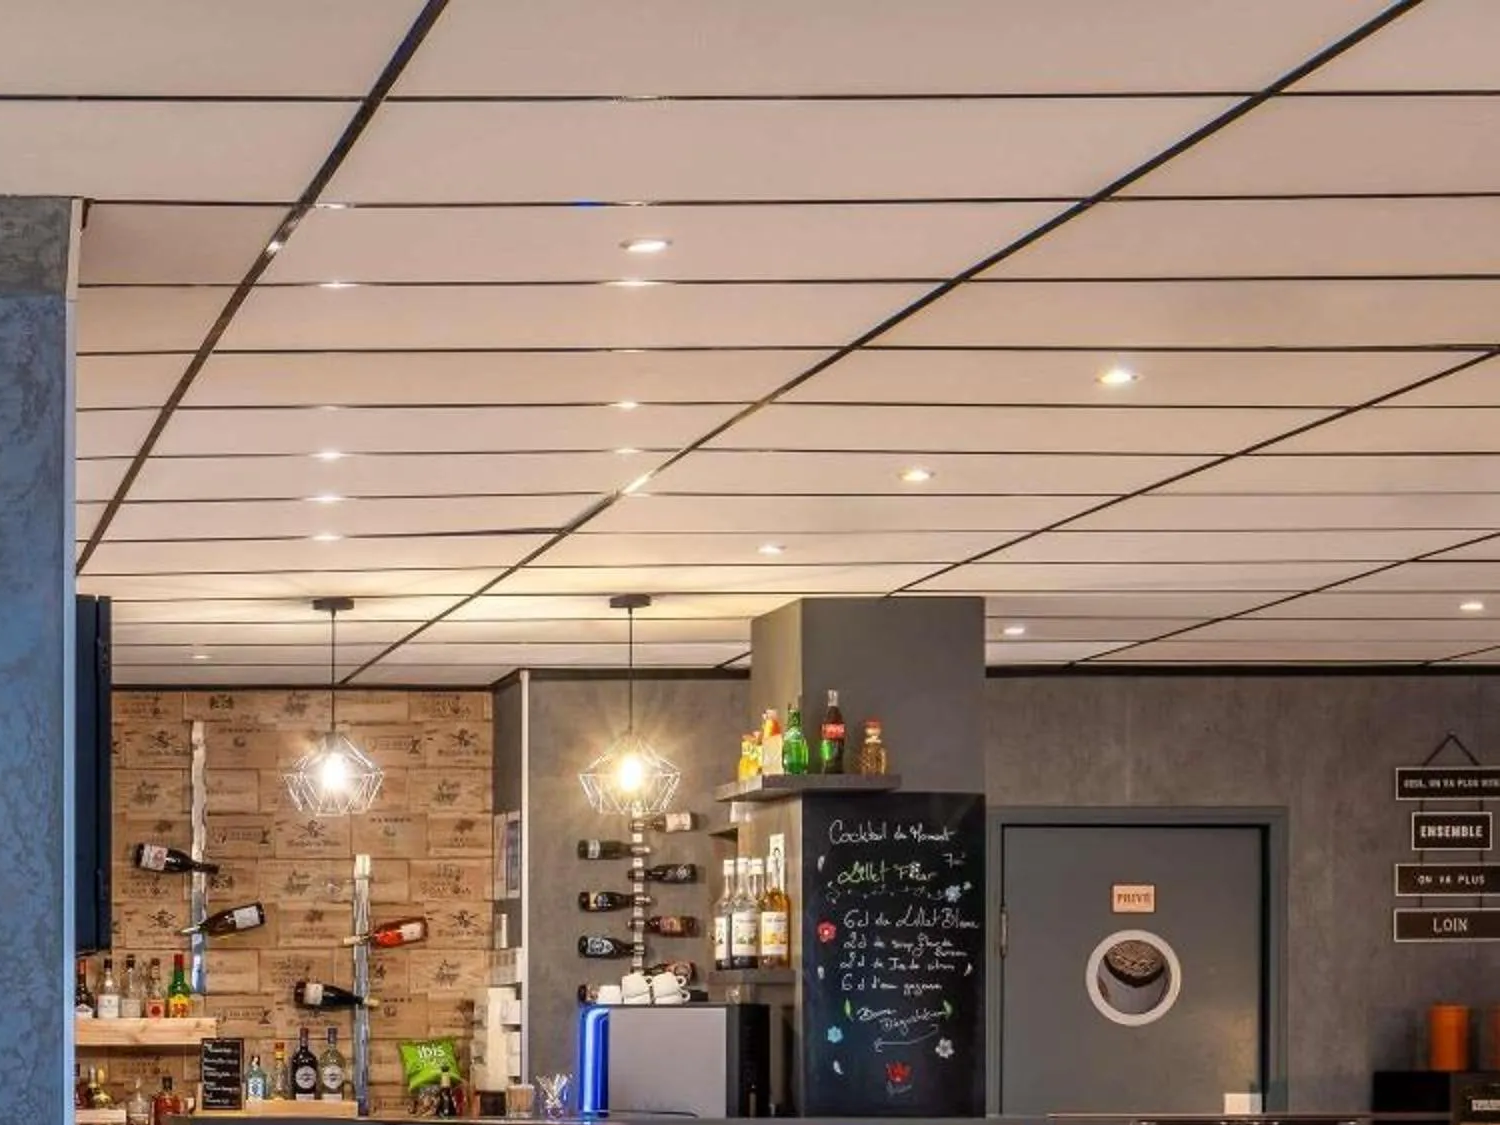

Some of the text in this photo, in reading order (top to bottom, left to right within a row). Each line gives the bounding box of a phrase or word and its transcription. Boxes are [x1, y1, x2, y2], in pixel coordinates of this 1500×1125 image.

[829, 819, 887, 844] Cocktail
[1420, 825, 1483, 838] ENSEMBLE
[1417, 875, 1485, 885] ON VA PLUS
[1433, 917, 1469, 933] LOIN
